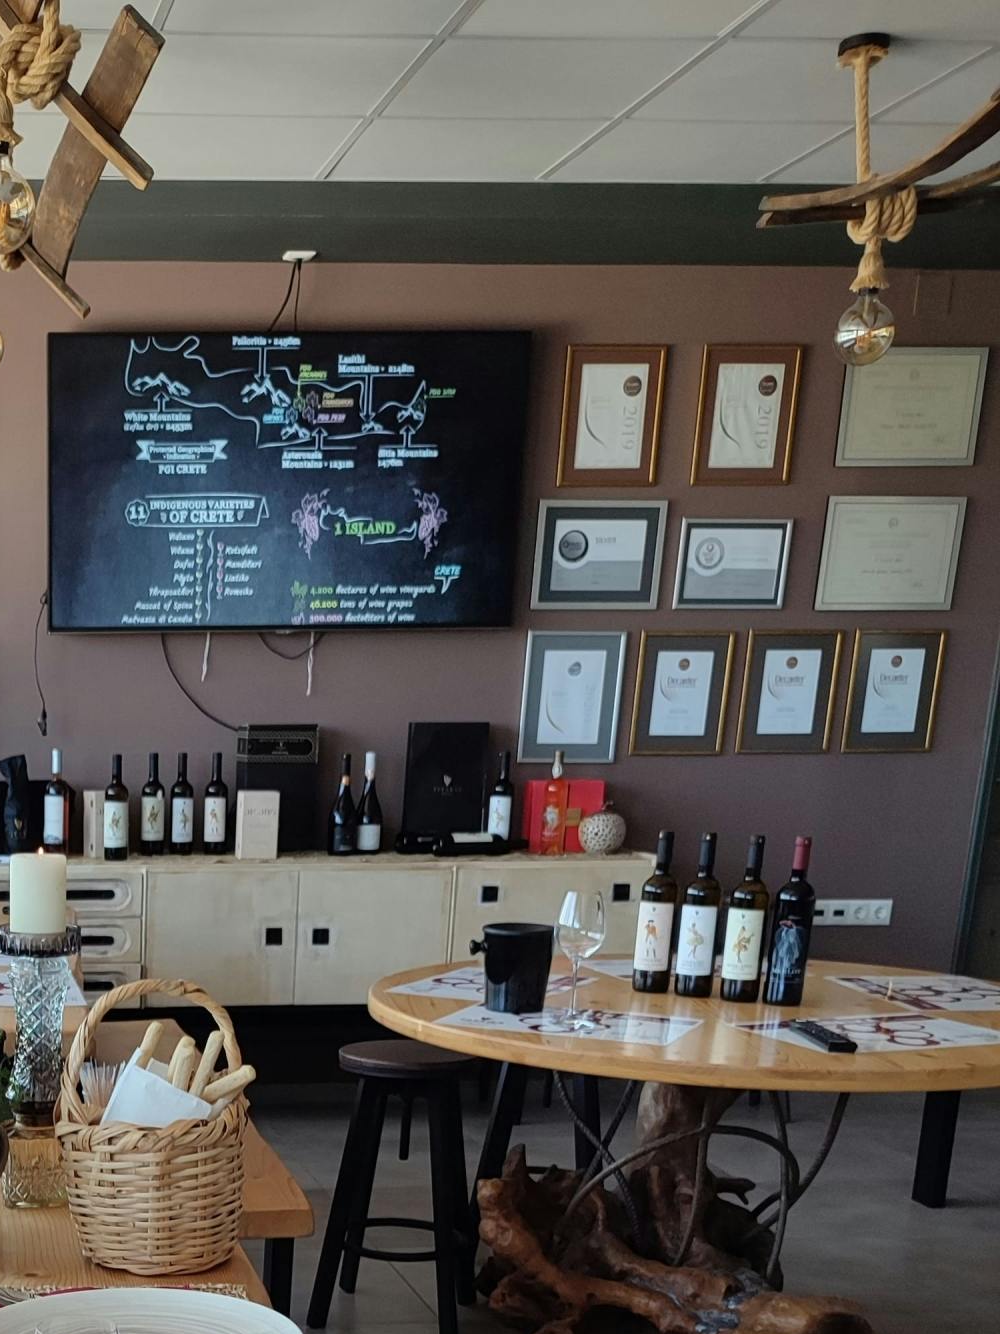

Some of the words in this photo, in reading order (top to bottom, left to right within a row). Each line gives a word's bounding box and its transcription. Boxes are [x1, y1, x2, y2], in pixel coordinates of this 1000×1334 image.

[338, 364, 380, 374] Mountains
[124, 413, 148, 422] White
[150, 413, 191, 422] Mountains
[620, 405, 638, 450] 2019
[755, 405, 772, 450] 2019
[397, 449, 439, 458] Mountains
[158, 464, 175, 474] PGI
[176, 464, 207, 474] CRETE
[282, 460, 322, 468] Mountains
[150, 500, 207, 510] INDIGENOUS
[207, 500, 255, 509] VARIETIES
[129, 505, 146, 520] 11
[169, 511, 188, 523] OF
[190, 511, 235, 523] CRETE
[334, 523, 342, 536] 1
[346, 522, 396, 535] ISLAND
[434, 565, 462, 576] CRETE
